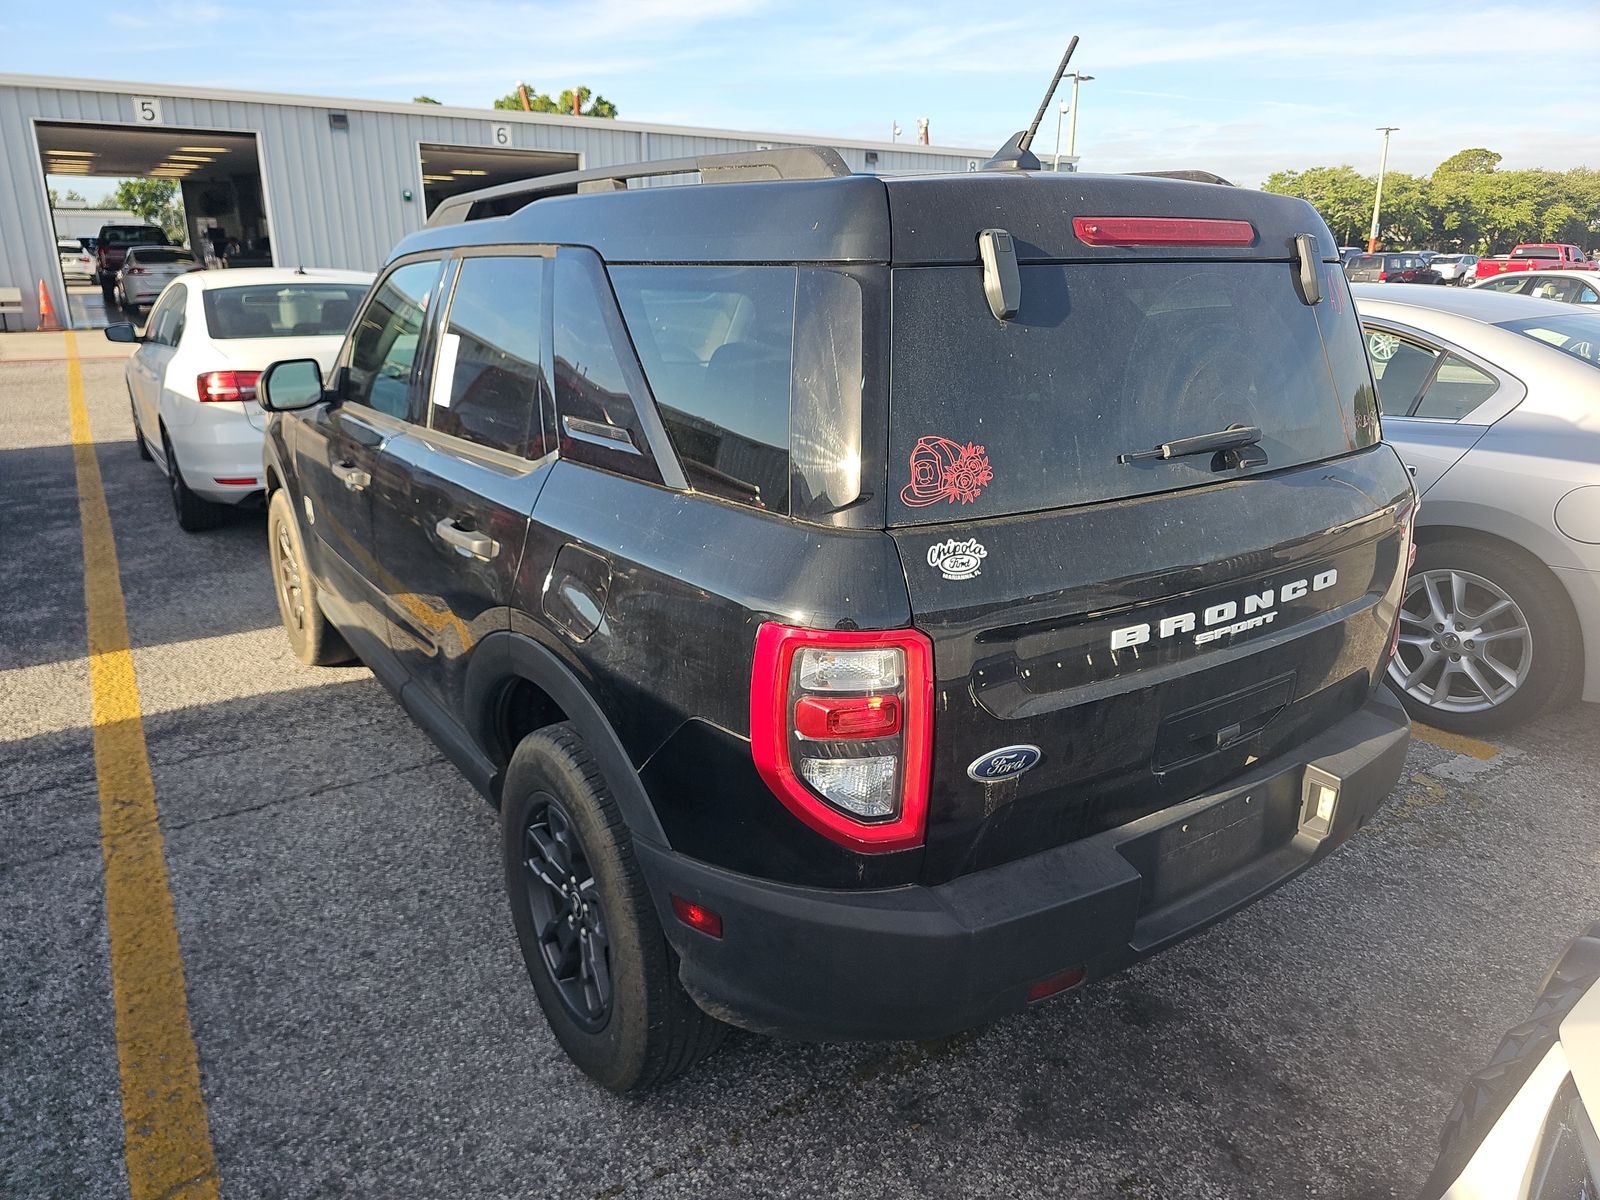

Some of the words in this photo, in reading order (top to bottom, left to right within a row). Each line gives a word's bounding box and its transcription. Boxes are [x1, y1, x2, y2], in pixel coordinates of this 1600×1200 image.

[141, 101, 155, 121] 5
[497, 127, 508, 145] 6
[928, 539, 987, 567] Chipola
[949, 557, 971, 569] Ford
[1111, 568, 1338, 651] BRONCO
[1193, 610, 1278, 645] SPORT
[986, 753, 1027, 776] Ford
